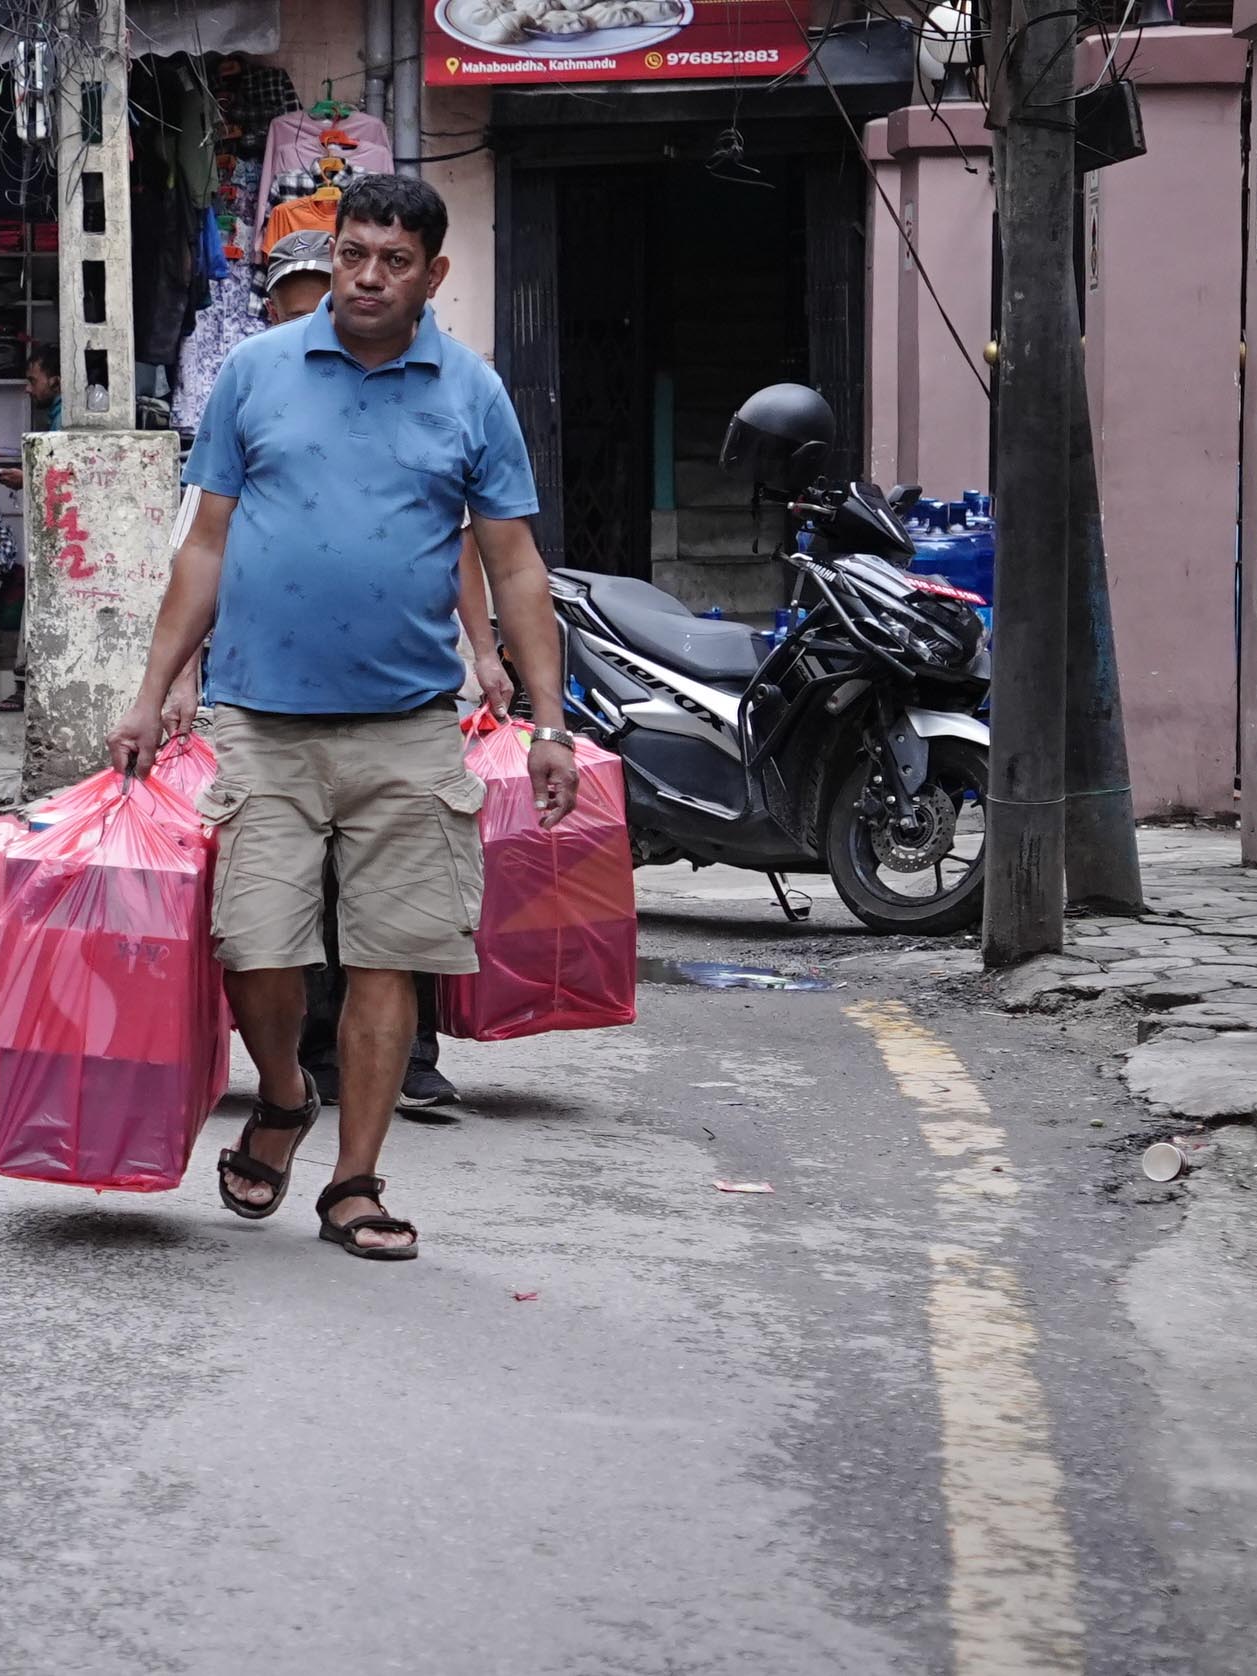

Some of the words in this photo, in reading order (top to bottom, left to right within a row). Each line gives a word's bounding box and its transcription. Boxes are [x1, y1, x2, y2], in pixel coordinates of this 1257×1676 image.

[666, 50, 779, 65] 9768522883
[462, 60, 547, 73] Mahabouddha,
[549, 58, 616, 71] Kathmandu
[806, 562, 837, 582] YAMAHA
